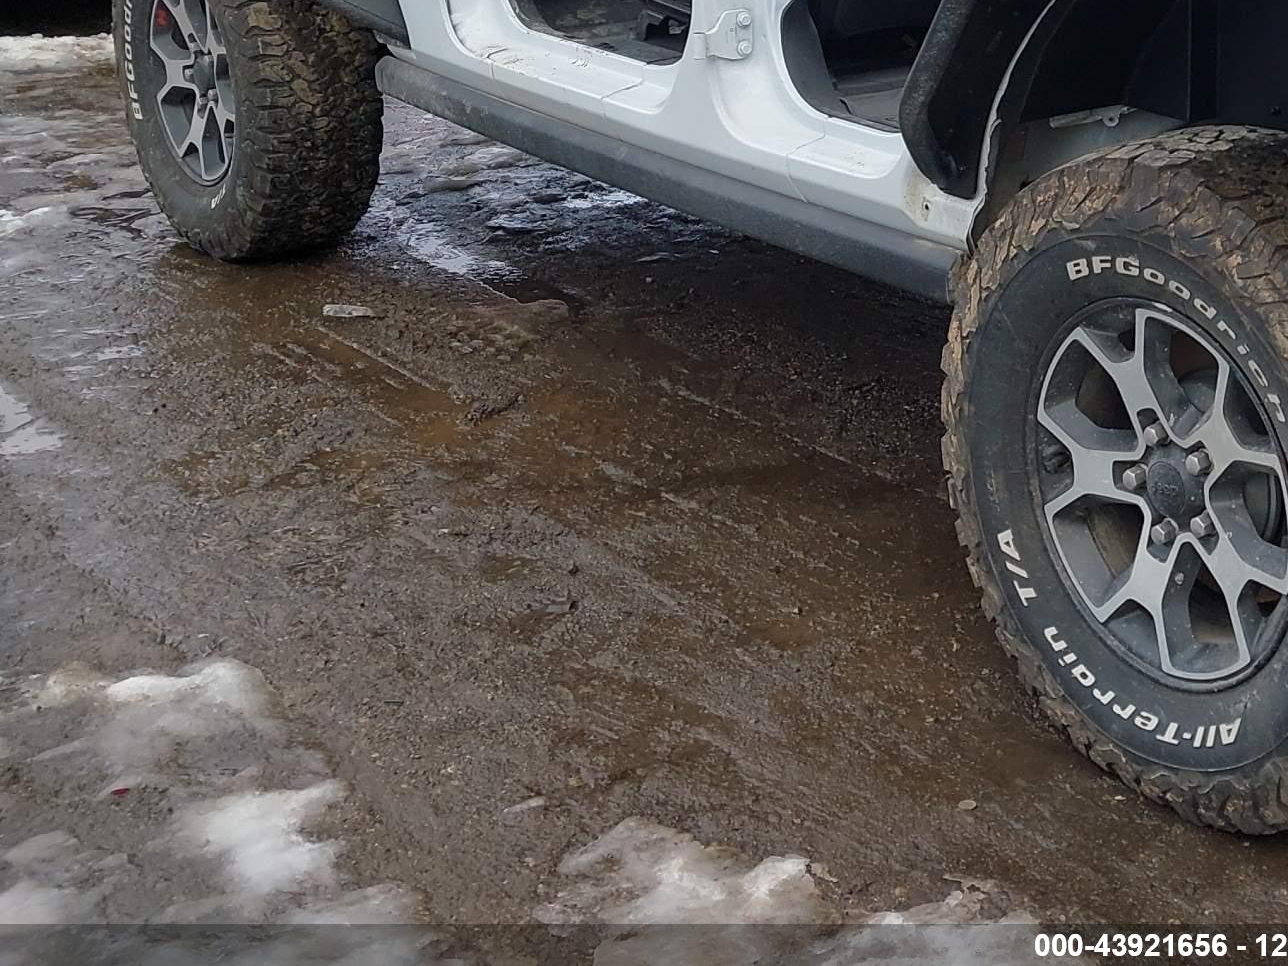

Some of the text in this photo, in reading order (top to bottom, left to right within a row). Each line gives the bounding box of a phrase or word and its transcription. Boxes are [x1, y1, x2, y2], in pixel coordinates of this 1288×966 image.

[1066, 255, 1286, 423] BFGoodrich
[997, 529, 1242, 748] All-Terrain T/A
